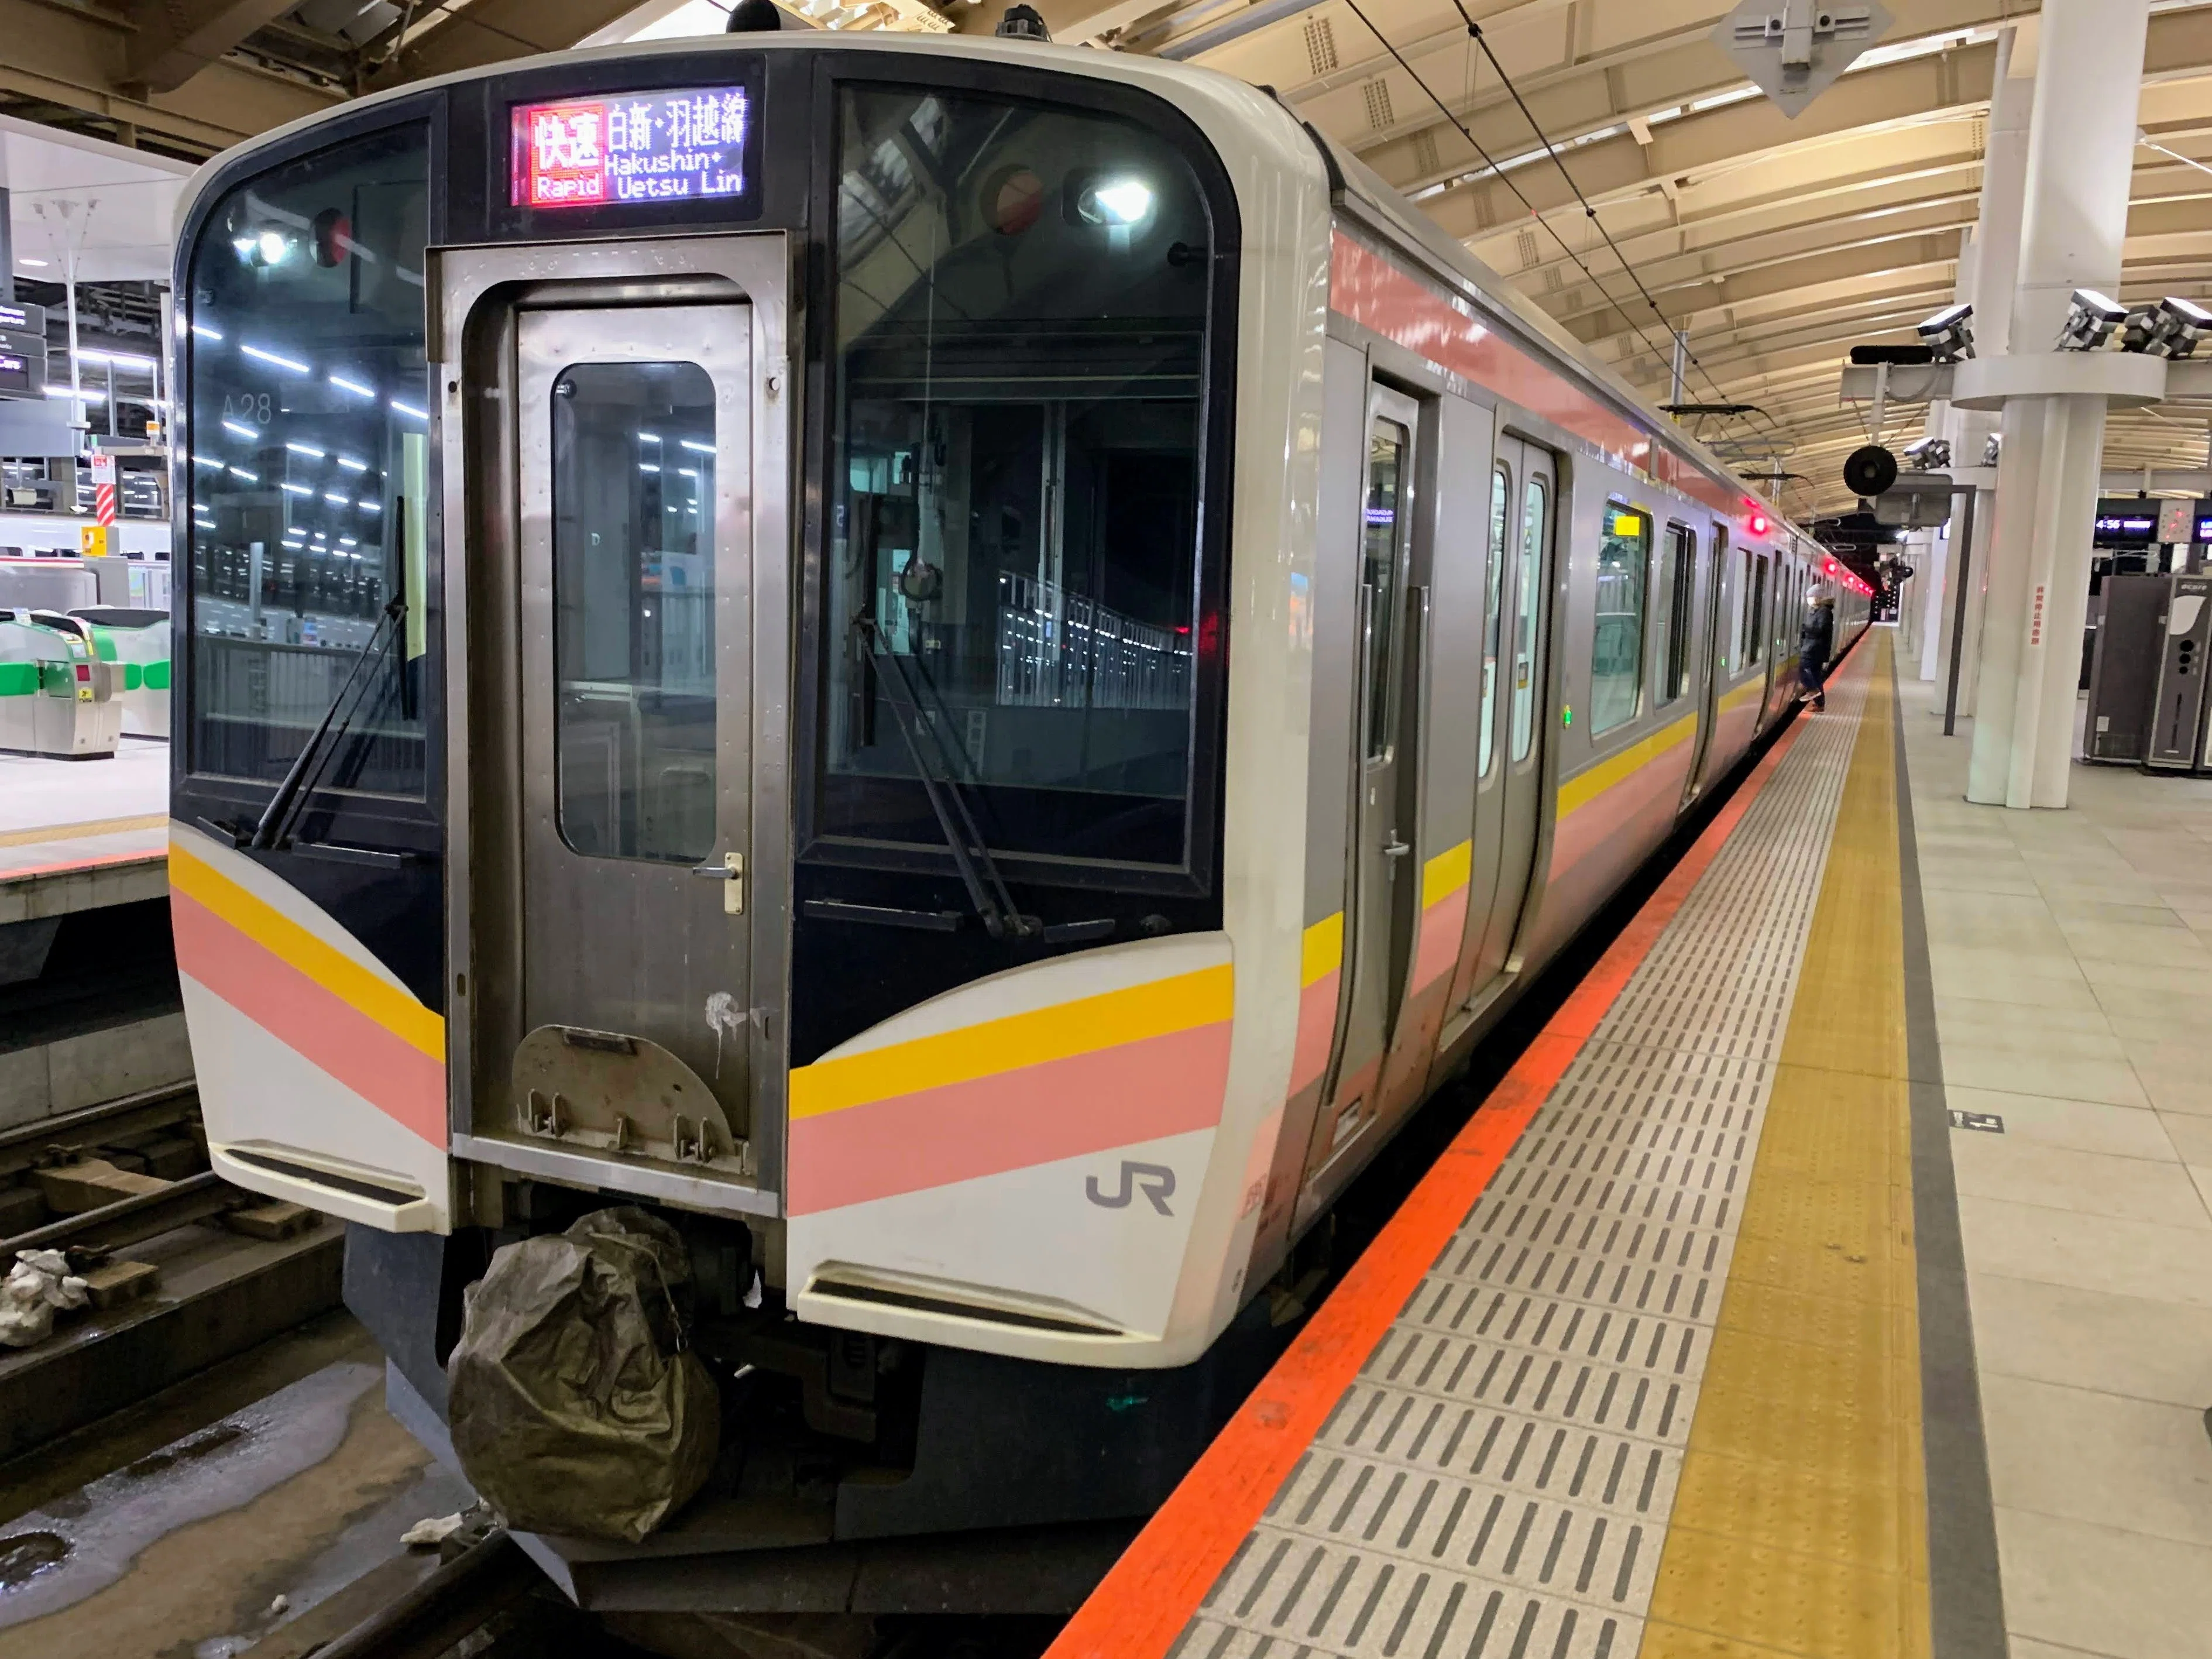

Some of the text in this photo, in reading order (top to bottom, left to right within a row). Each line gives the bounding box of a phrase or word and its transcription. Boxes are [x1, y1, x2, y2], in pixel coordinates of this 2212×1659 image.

[535, 113, 599, 170] 快速
[537, 175, 600, 198] Rapid
[617, 177, 688, 199] Uetsu
[1086, 1160, 1176, 1217] JR
